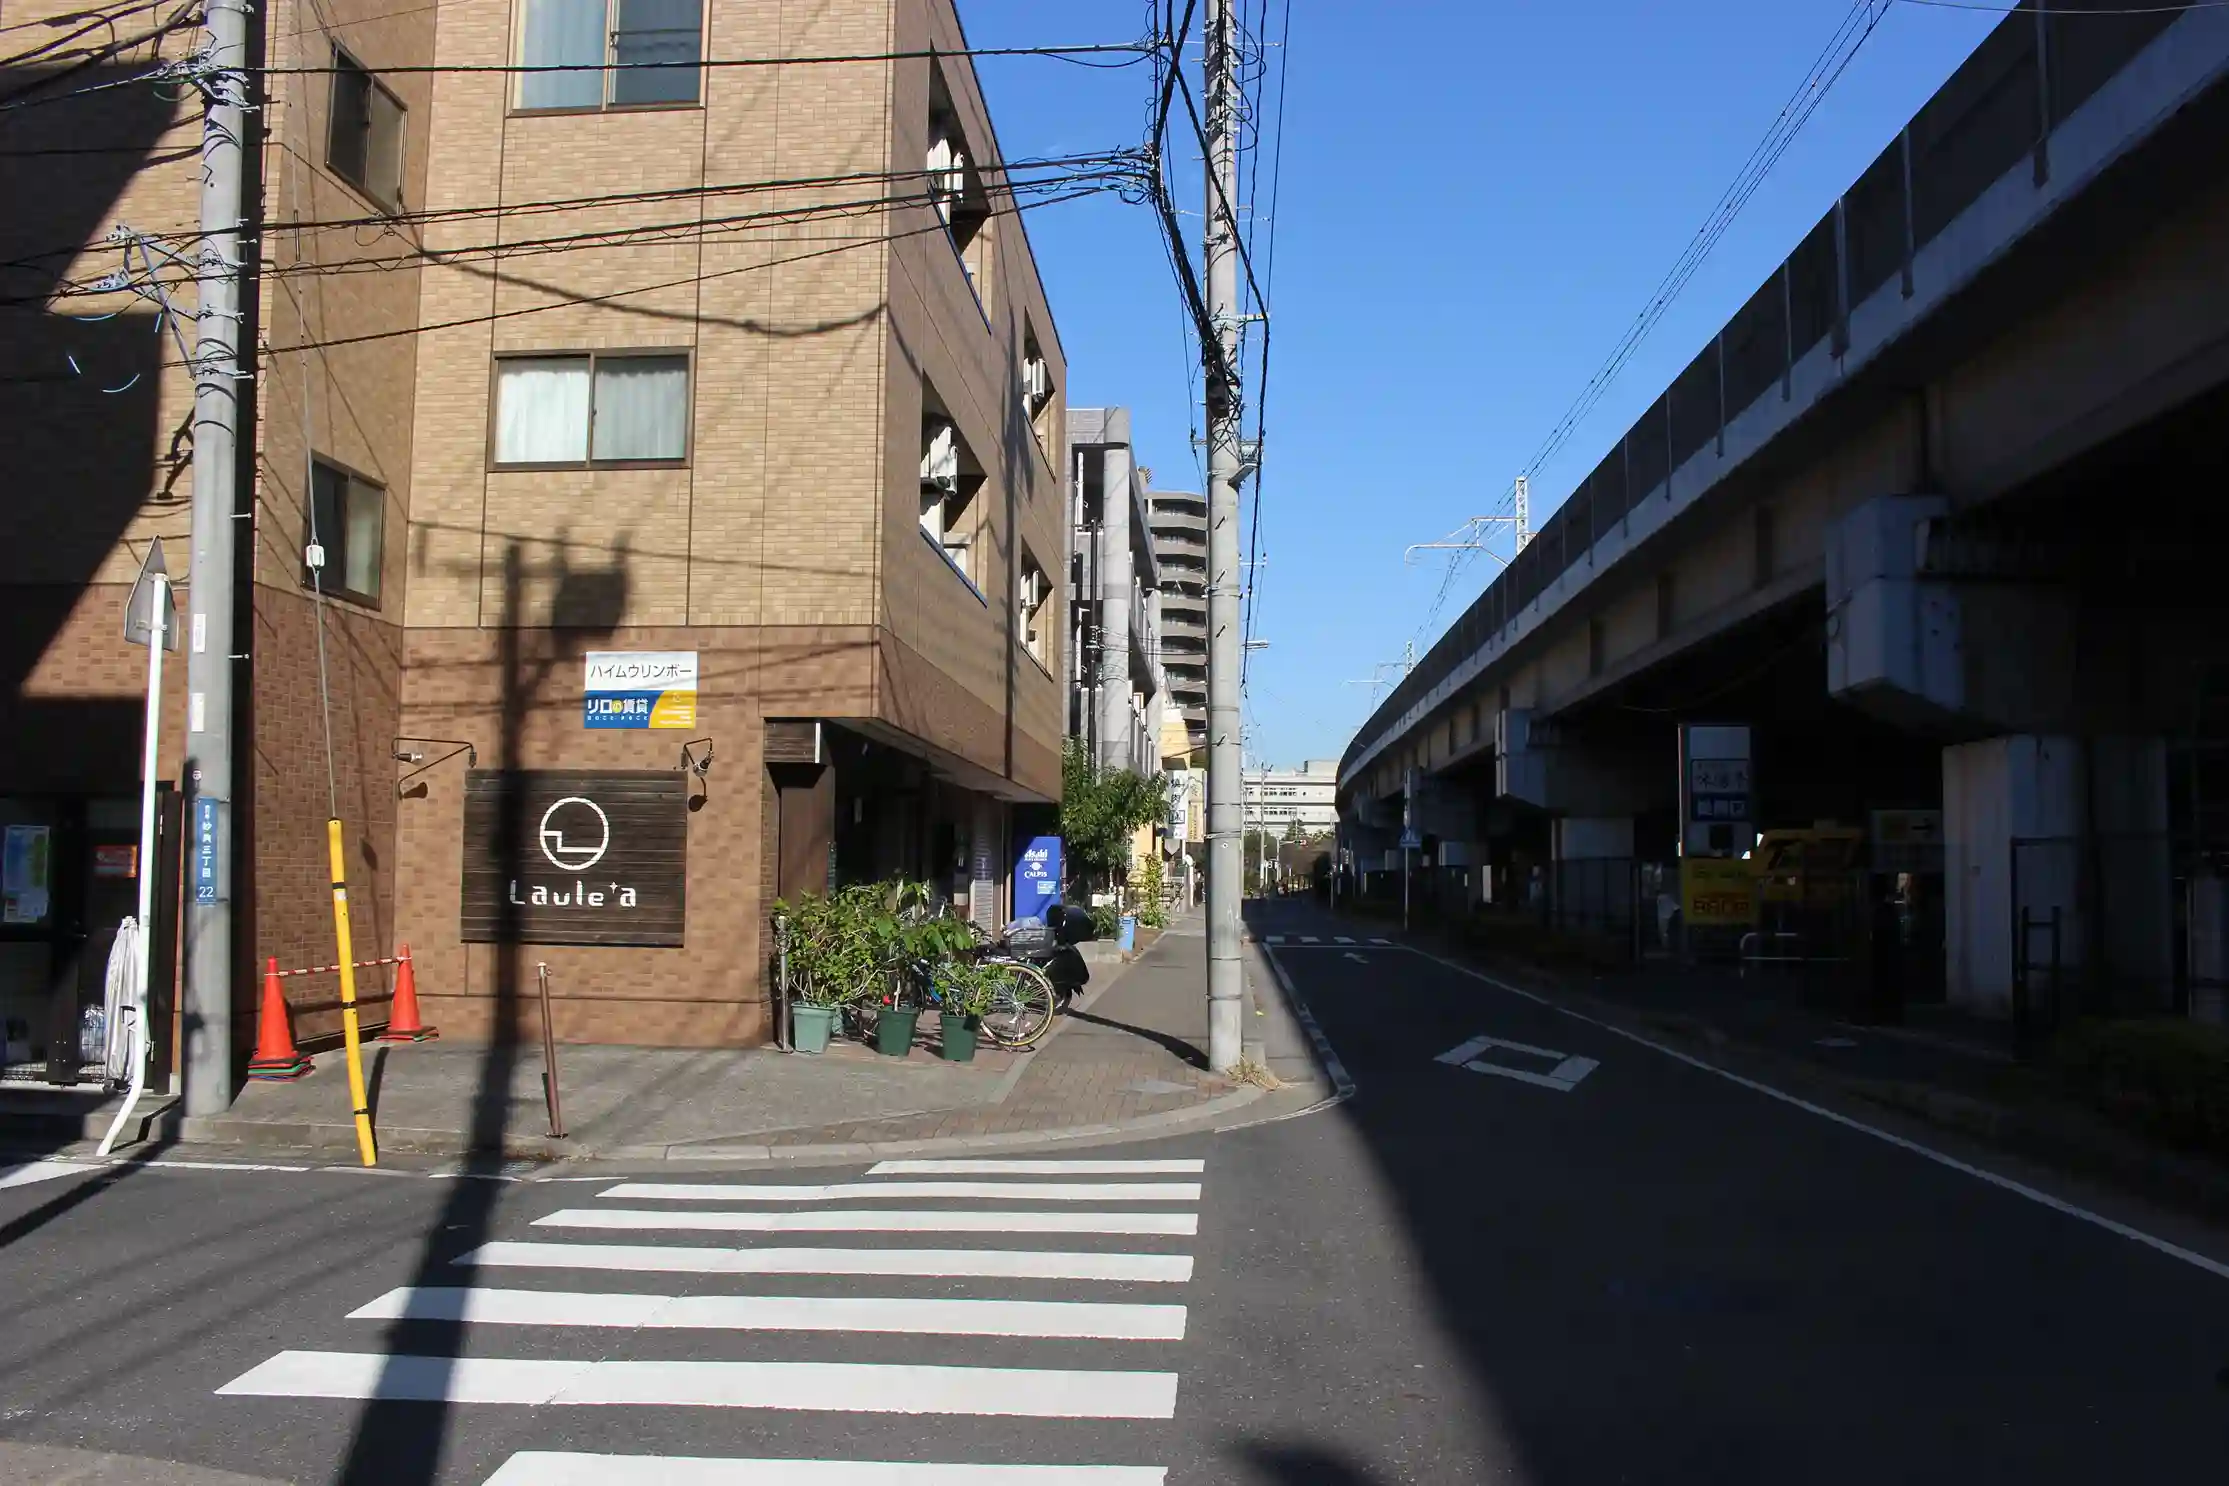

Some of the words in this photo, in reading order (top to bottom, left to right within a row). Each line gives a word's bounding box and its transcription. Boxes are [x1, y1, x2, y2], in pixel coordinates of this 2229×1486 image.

[590, 663, 692, 679] ハイムウリンボー
[587, 698, 649, 714] リロの賃貸
[1024, 848, 1048, 859] Asahi
[1024, 870, 1048, 879] CALPIS
[198, 886, 214, 898] 22
